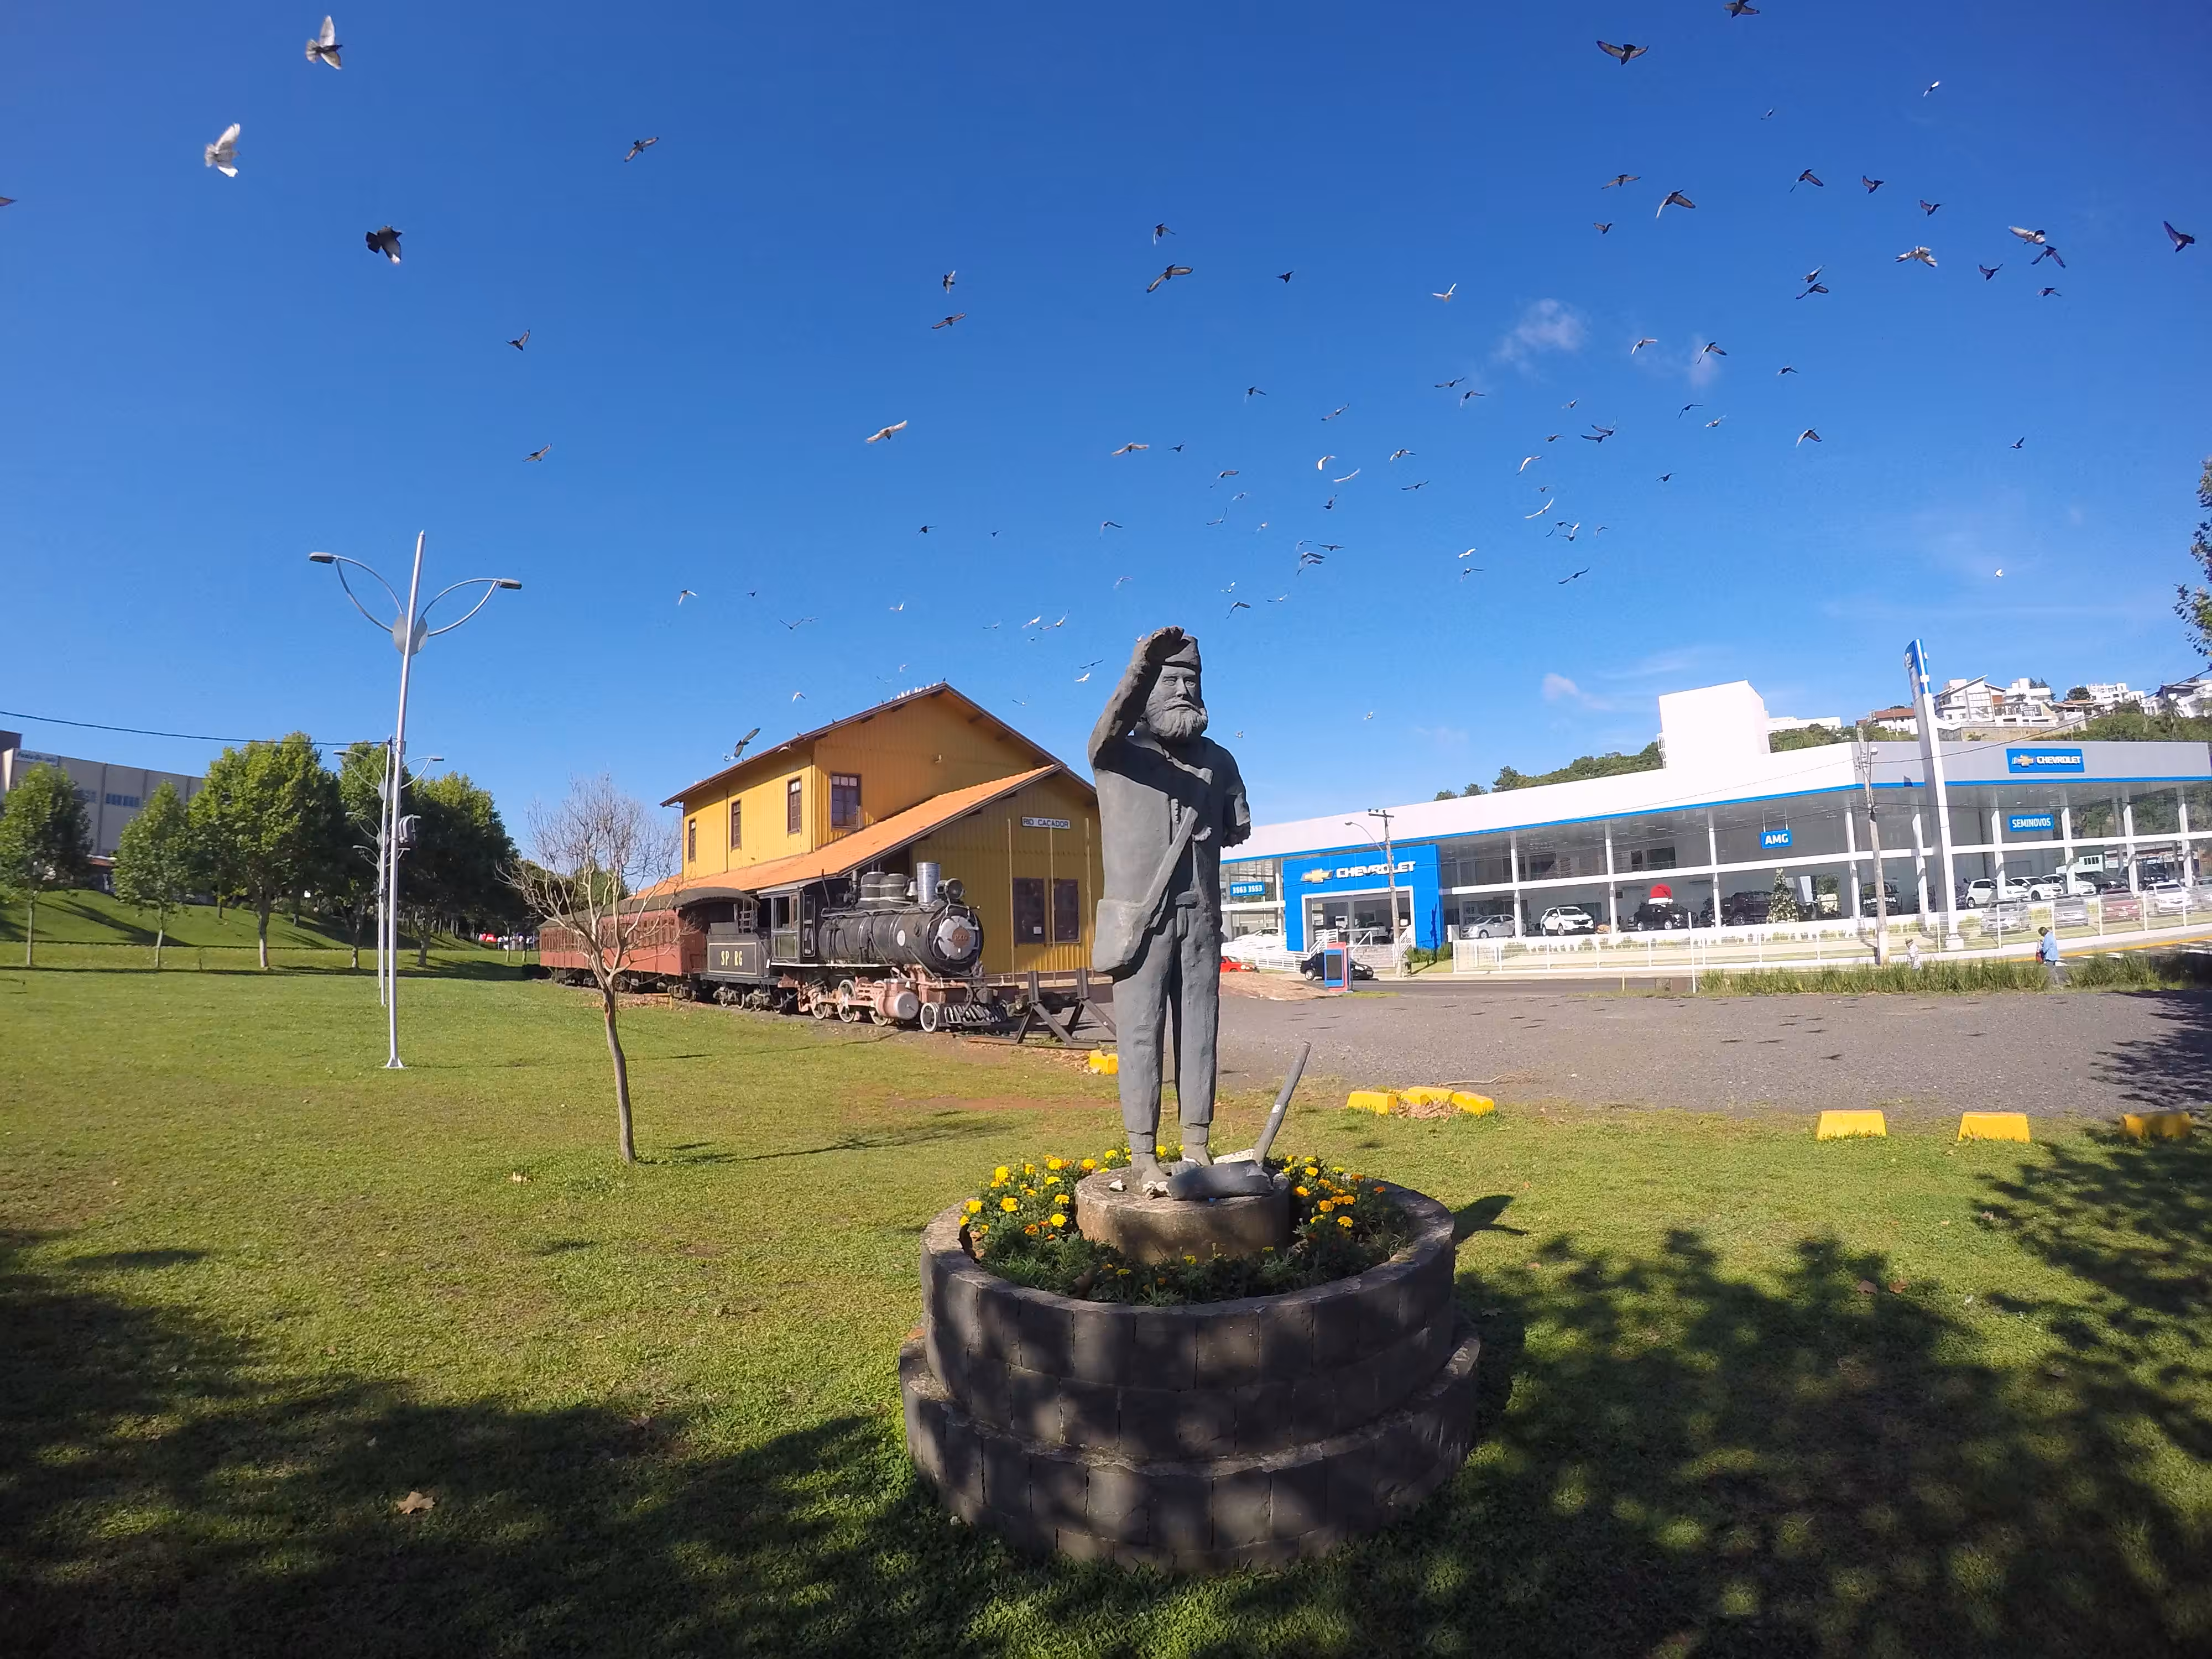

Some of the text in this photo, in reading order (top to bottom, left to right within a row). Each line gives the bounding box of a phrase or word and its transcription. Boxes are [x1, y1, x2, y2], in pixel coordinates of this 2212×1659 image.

[2012, 817, 2051, 828] SEMINOVOS
[1765, 833, 1788, 845] AMG
[1336, 860, 1416, 878] CHEVROLET
[721, 950, 743, 966] SP RG
